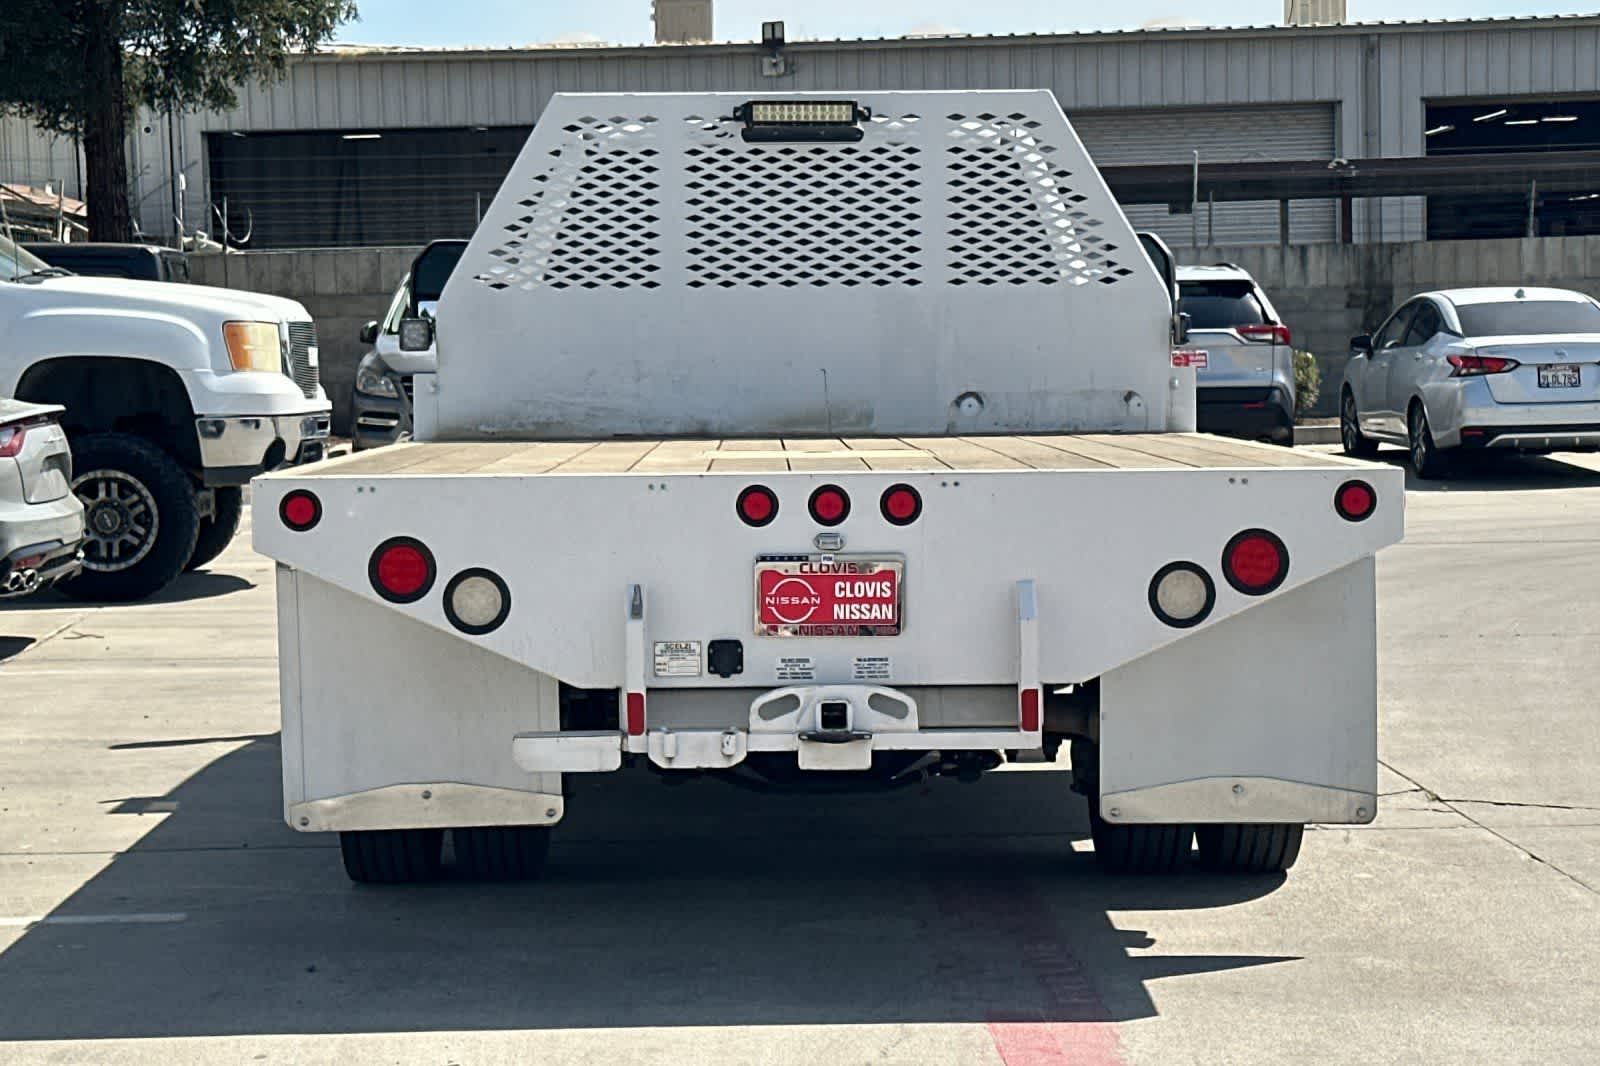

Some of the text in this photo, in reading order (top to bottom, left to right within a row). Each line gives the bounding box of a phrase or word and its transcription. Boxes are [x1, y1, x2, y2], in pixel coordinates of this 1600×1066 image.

[799, 562, 858, 574] CLOVIS
[834, 581, 891, 598] CLOVIS
[765, 596, 821, 605] NISSAN
[833, 603, 893, 620] NISSAN
[798, 625, 859, 636] NISSAN
